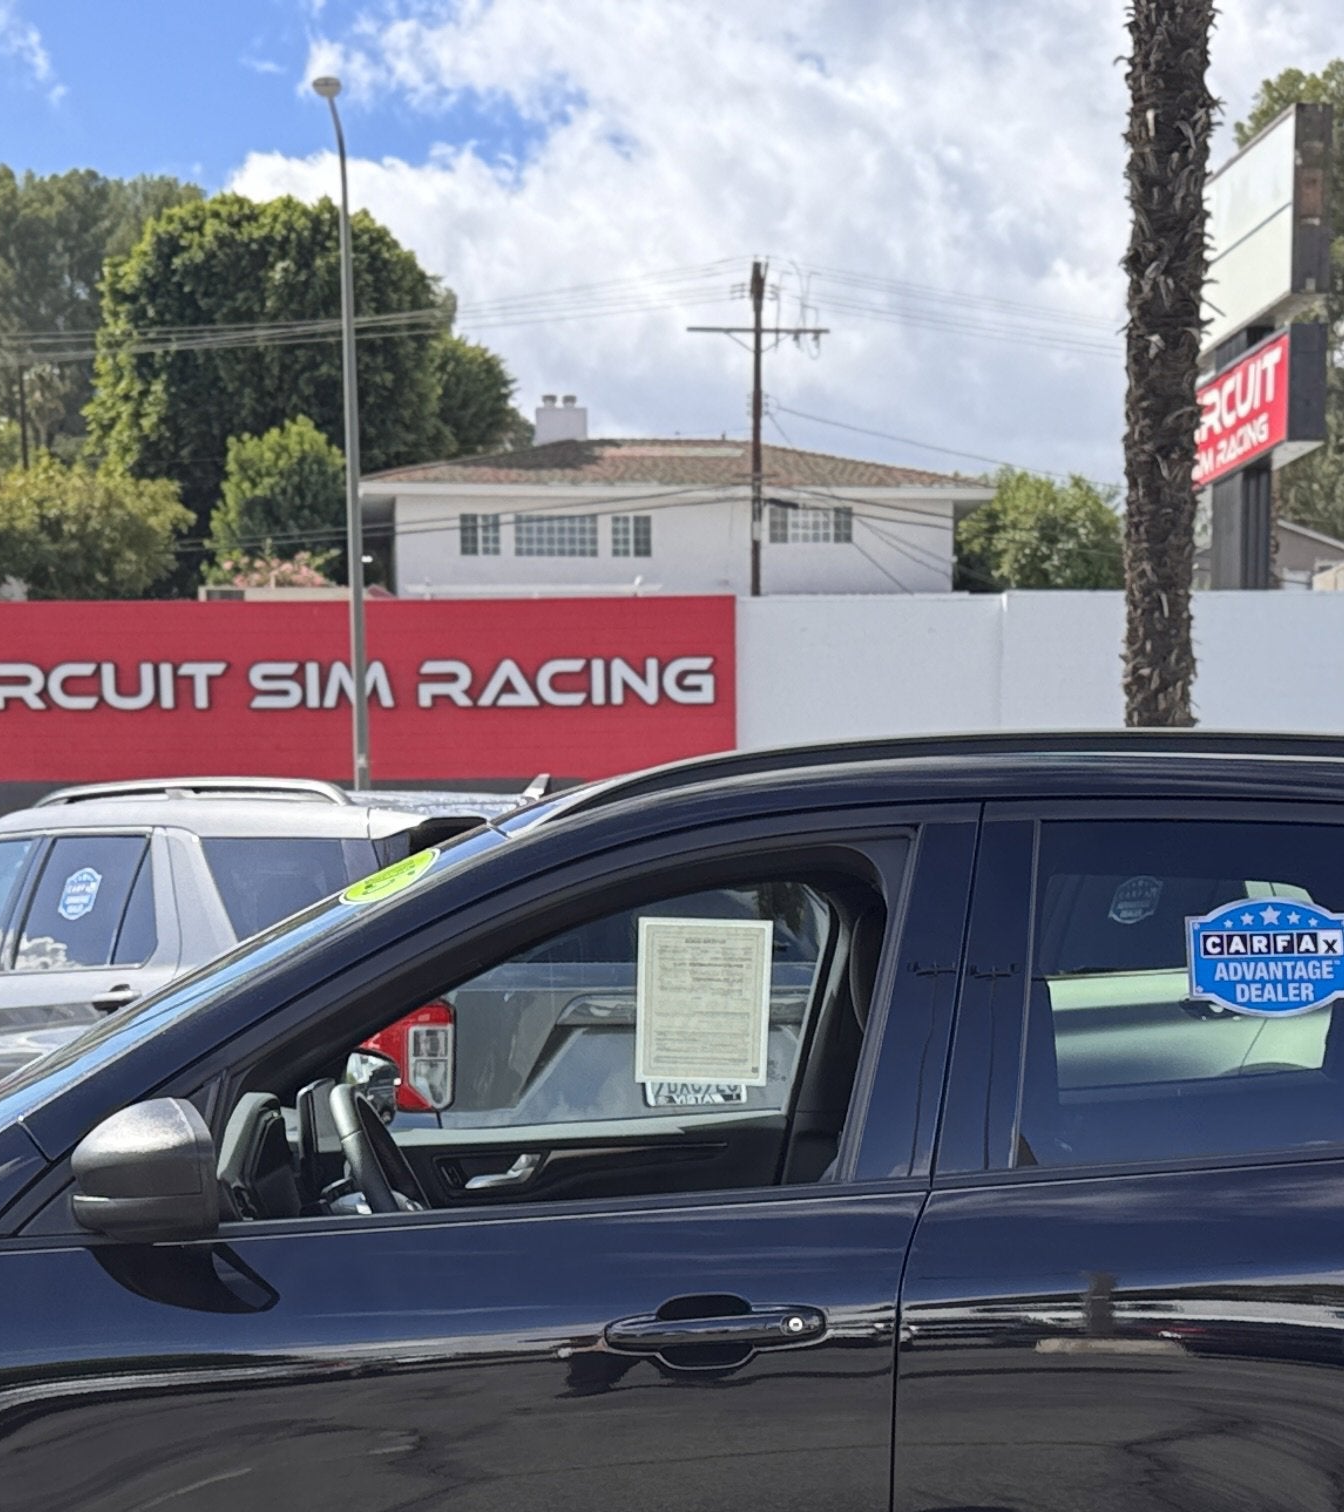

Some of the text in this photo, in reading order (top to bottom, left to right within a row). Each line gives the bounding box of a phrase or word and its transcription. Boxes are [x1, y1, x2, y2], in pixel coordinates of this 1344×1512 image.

[1194, 347, 1282, 445] RCUIT
[1215, 412, 1270, 468] RACING
[248, 660, 395, 709] SIM
[418, 656, 715, 708] RACING
[1204, 933, 1340, 955] CARFAX
[1235, 983, 1315, 1003] DEALER
